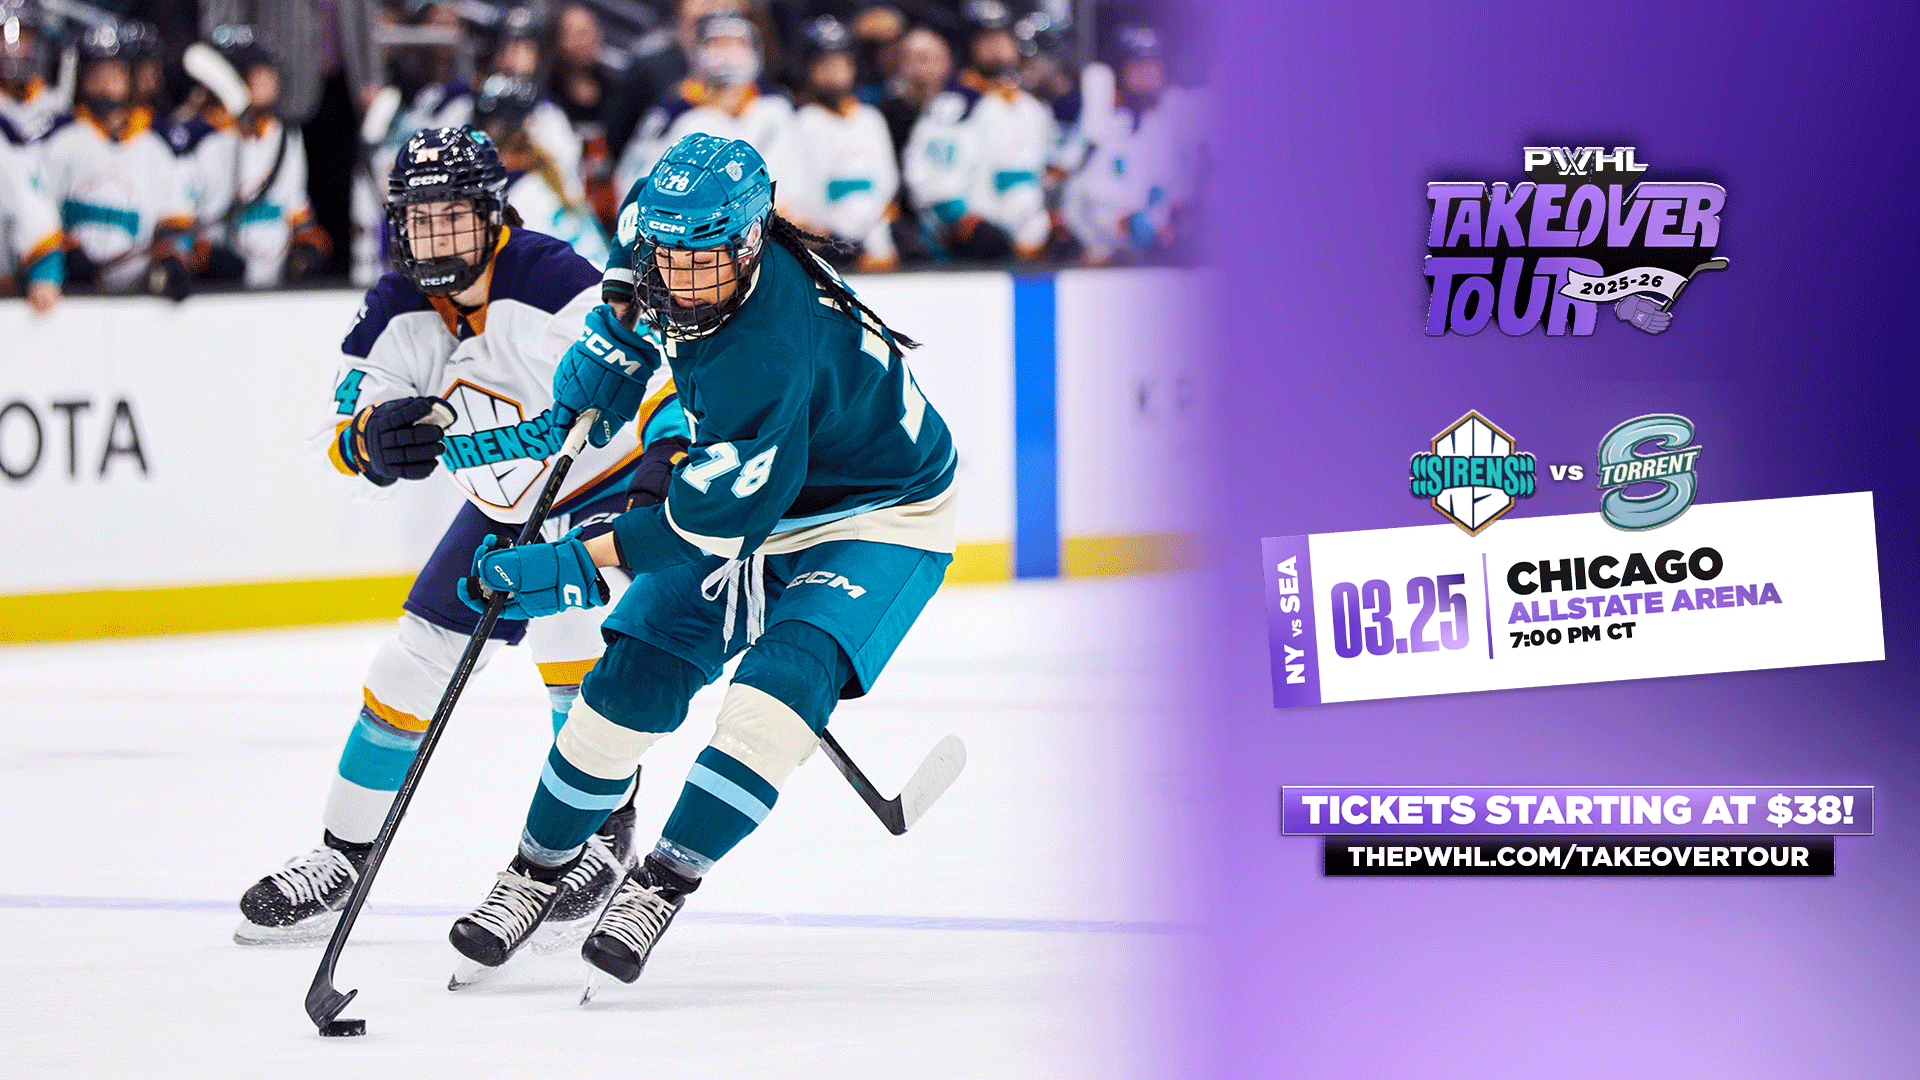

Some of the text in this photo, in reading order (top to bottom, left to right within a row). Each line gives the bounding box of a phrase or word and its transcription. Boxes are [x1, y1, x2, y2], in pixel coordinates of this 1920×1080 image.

[408, 173, 449, 187] CCM
[665, 174, 690, 192] 78
[648, 219, 686, 235] CCM
[420, 274, 456, 287] CCM
[681, 441, 779, 499] 78
[493, 564, 514, 587] CCM
[785, 570, 868, 600] CCM
